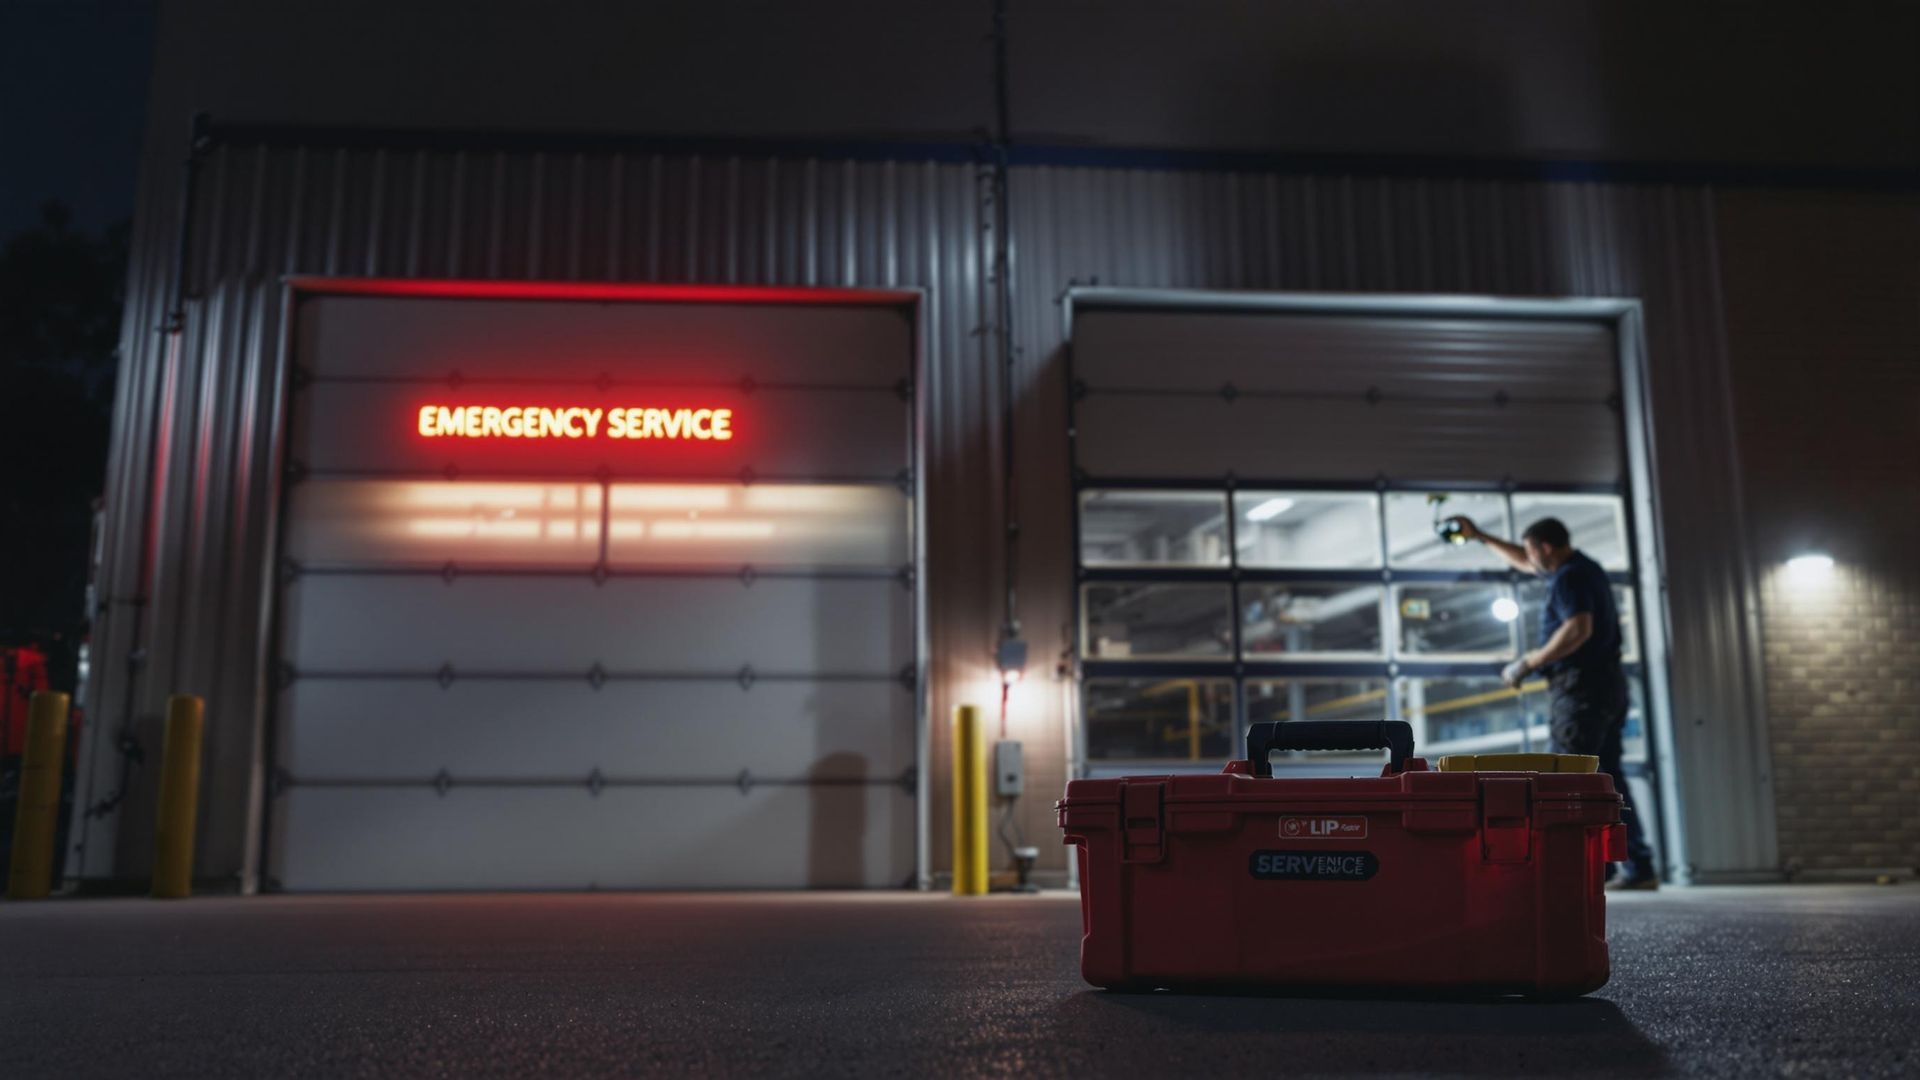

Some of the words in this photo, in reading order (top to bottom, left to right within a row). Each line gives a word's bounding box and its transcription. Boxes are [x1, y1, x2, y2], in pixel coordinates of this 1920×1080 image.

[418, 405, 602, 437] EMERGENCY
[607, 407, 733, 440] SERVICE
[1310, 819, 1338, 835] LIP
